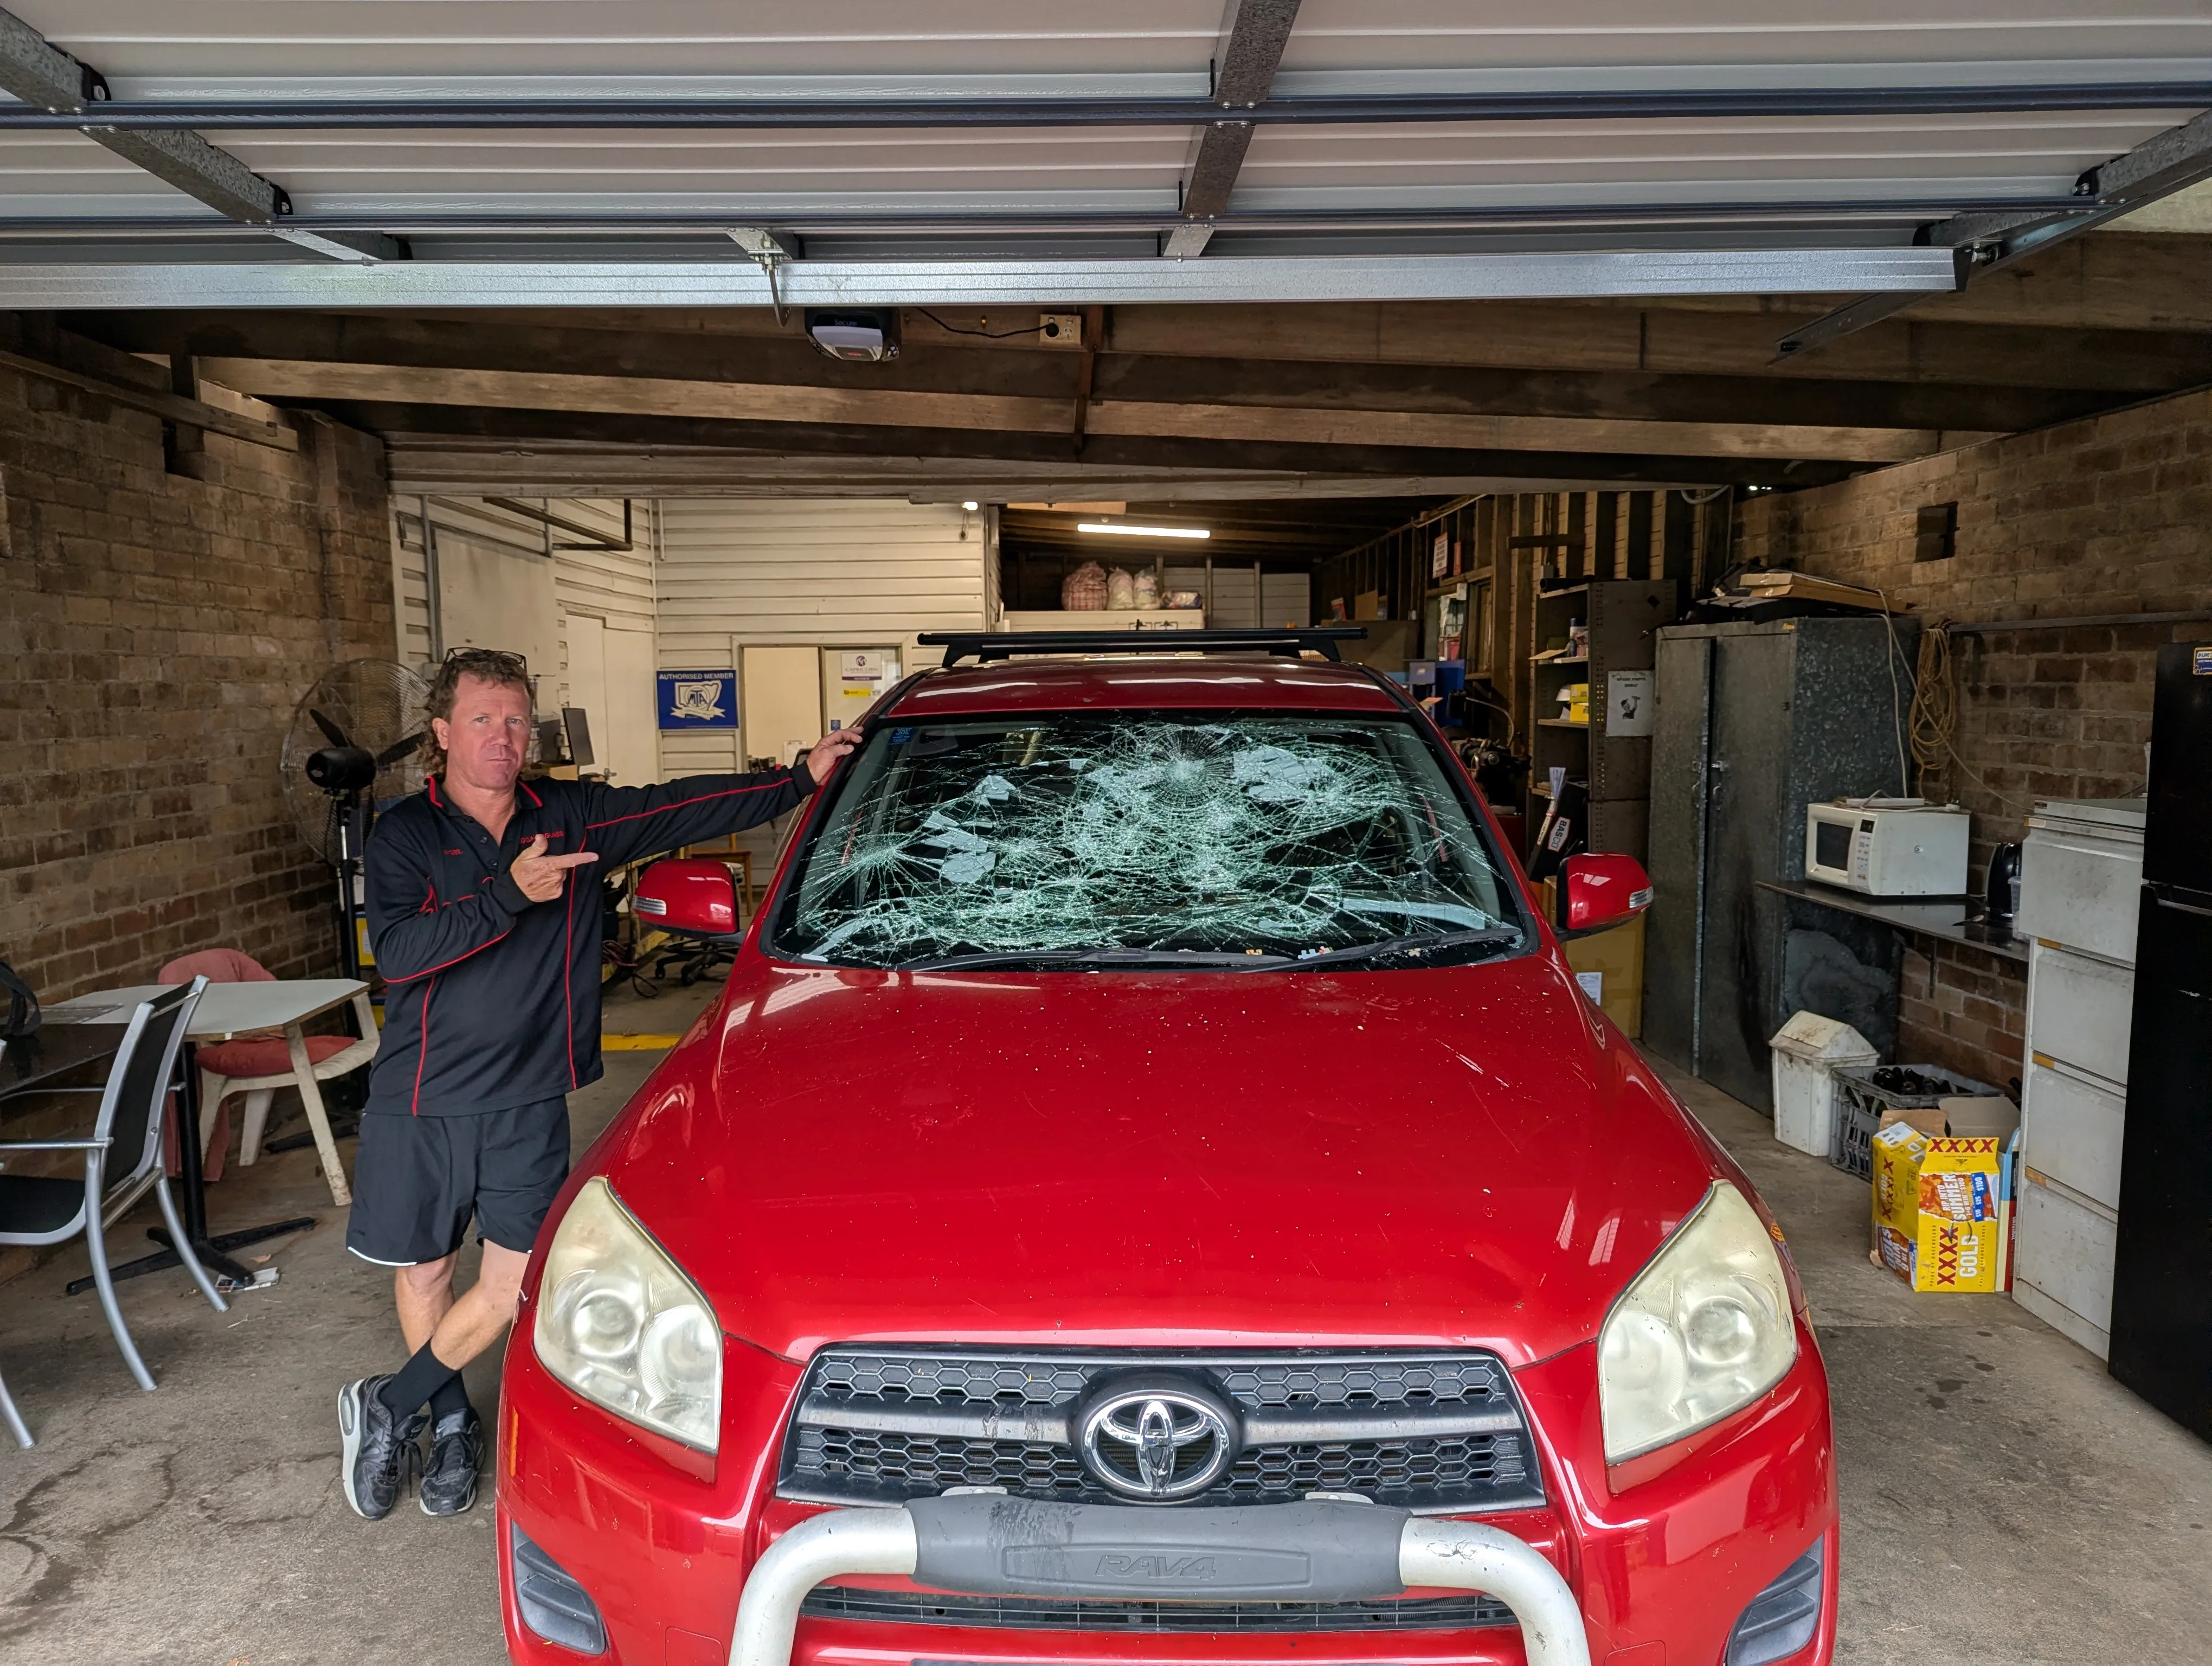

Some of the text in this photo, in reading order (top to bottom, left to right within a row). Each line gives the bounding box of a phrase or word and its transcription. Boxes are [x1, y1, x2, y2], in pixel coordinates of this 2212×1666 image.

[1551, 819, 1567, 849] BASCO
[1928, 1139, 1996, 1153] XXXX
[1958, 1177, 1966, 1190] $100
[1975, 1176, 1984, 1191] $100
[1937, 1184, 1951, 1211] RIP INTO
[1943, 1175, 1967, 1220] SUMMER
[1962, 1195, 1970, 1206] WIN
[1881, 1227, 1896, 1270] $100
[1892, 1242, 1902, 1267] WIN
[1901, 1253, 1907, 1262] IN
[1936, 1226, 1959, 1285] XXXX
[1959, 1235, 1979, 1277] GOLD
[1095, 1555, 1217, 1581] RAV4
